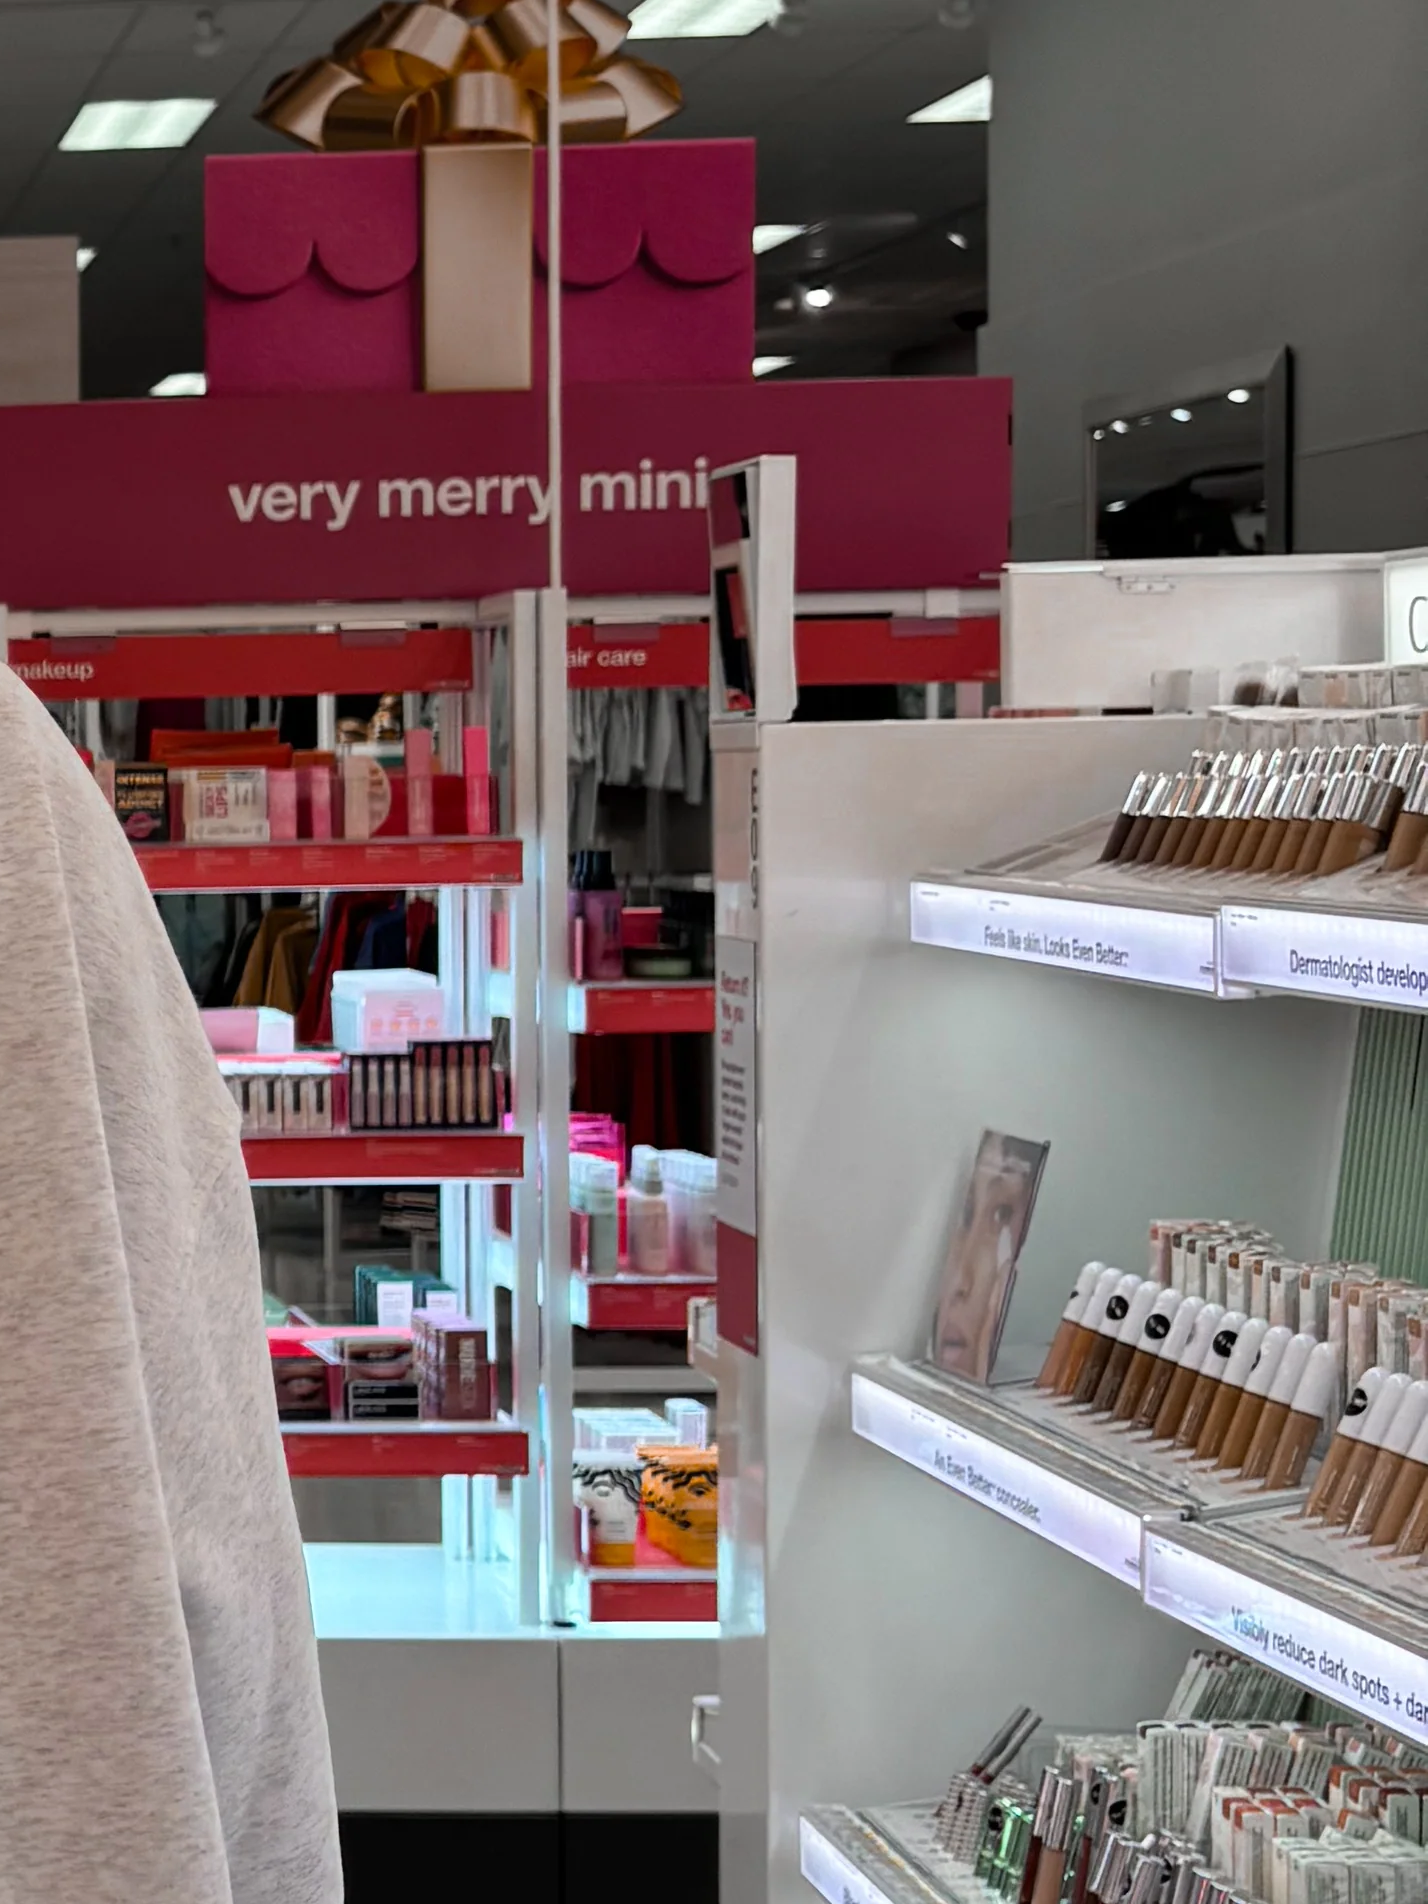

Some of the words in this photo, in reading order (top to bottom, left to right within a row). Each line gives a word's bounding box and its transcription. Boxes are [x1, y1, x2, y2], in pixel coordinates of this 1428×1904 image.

[228, 480, 360, 531] very
[379, 474, 554, 526] merry
[596, 647, 646, 669] care
[984, 924, 1006, 949] Feels
[1044, 933, 1071, 960] Looks
[1072, 938, 1095, 964] Even
[1289, 949, 1374, 988] Dermatologist
[1377, 960, 1428, 995] develop
[1231, 1604, 1269, 1652] Visibly
[1272, 1629, 1316, 1669] reduce
[1319, 1649, 1348, 1686] dark
[1351, 1670, 1390, 1707] spots
[1392, 1693, 1402, 1712] +
